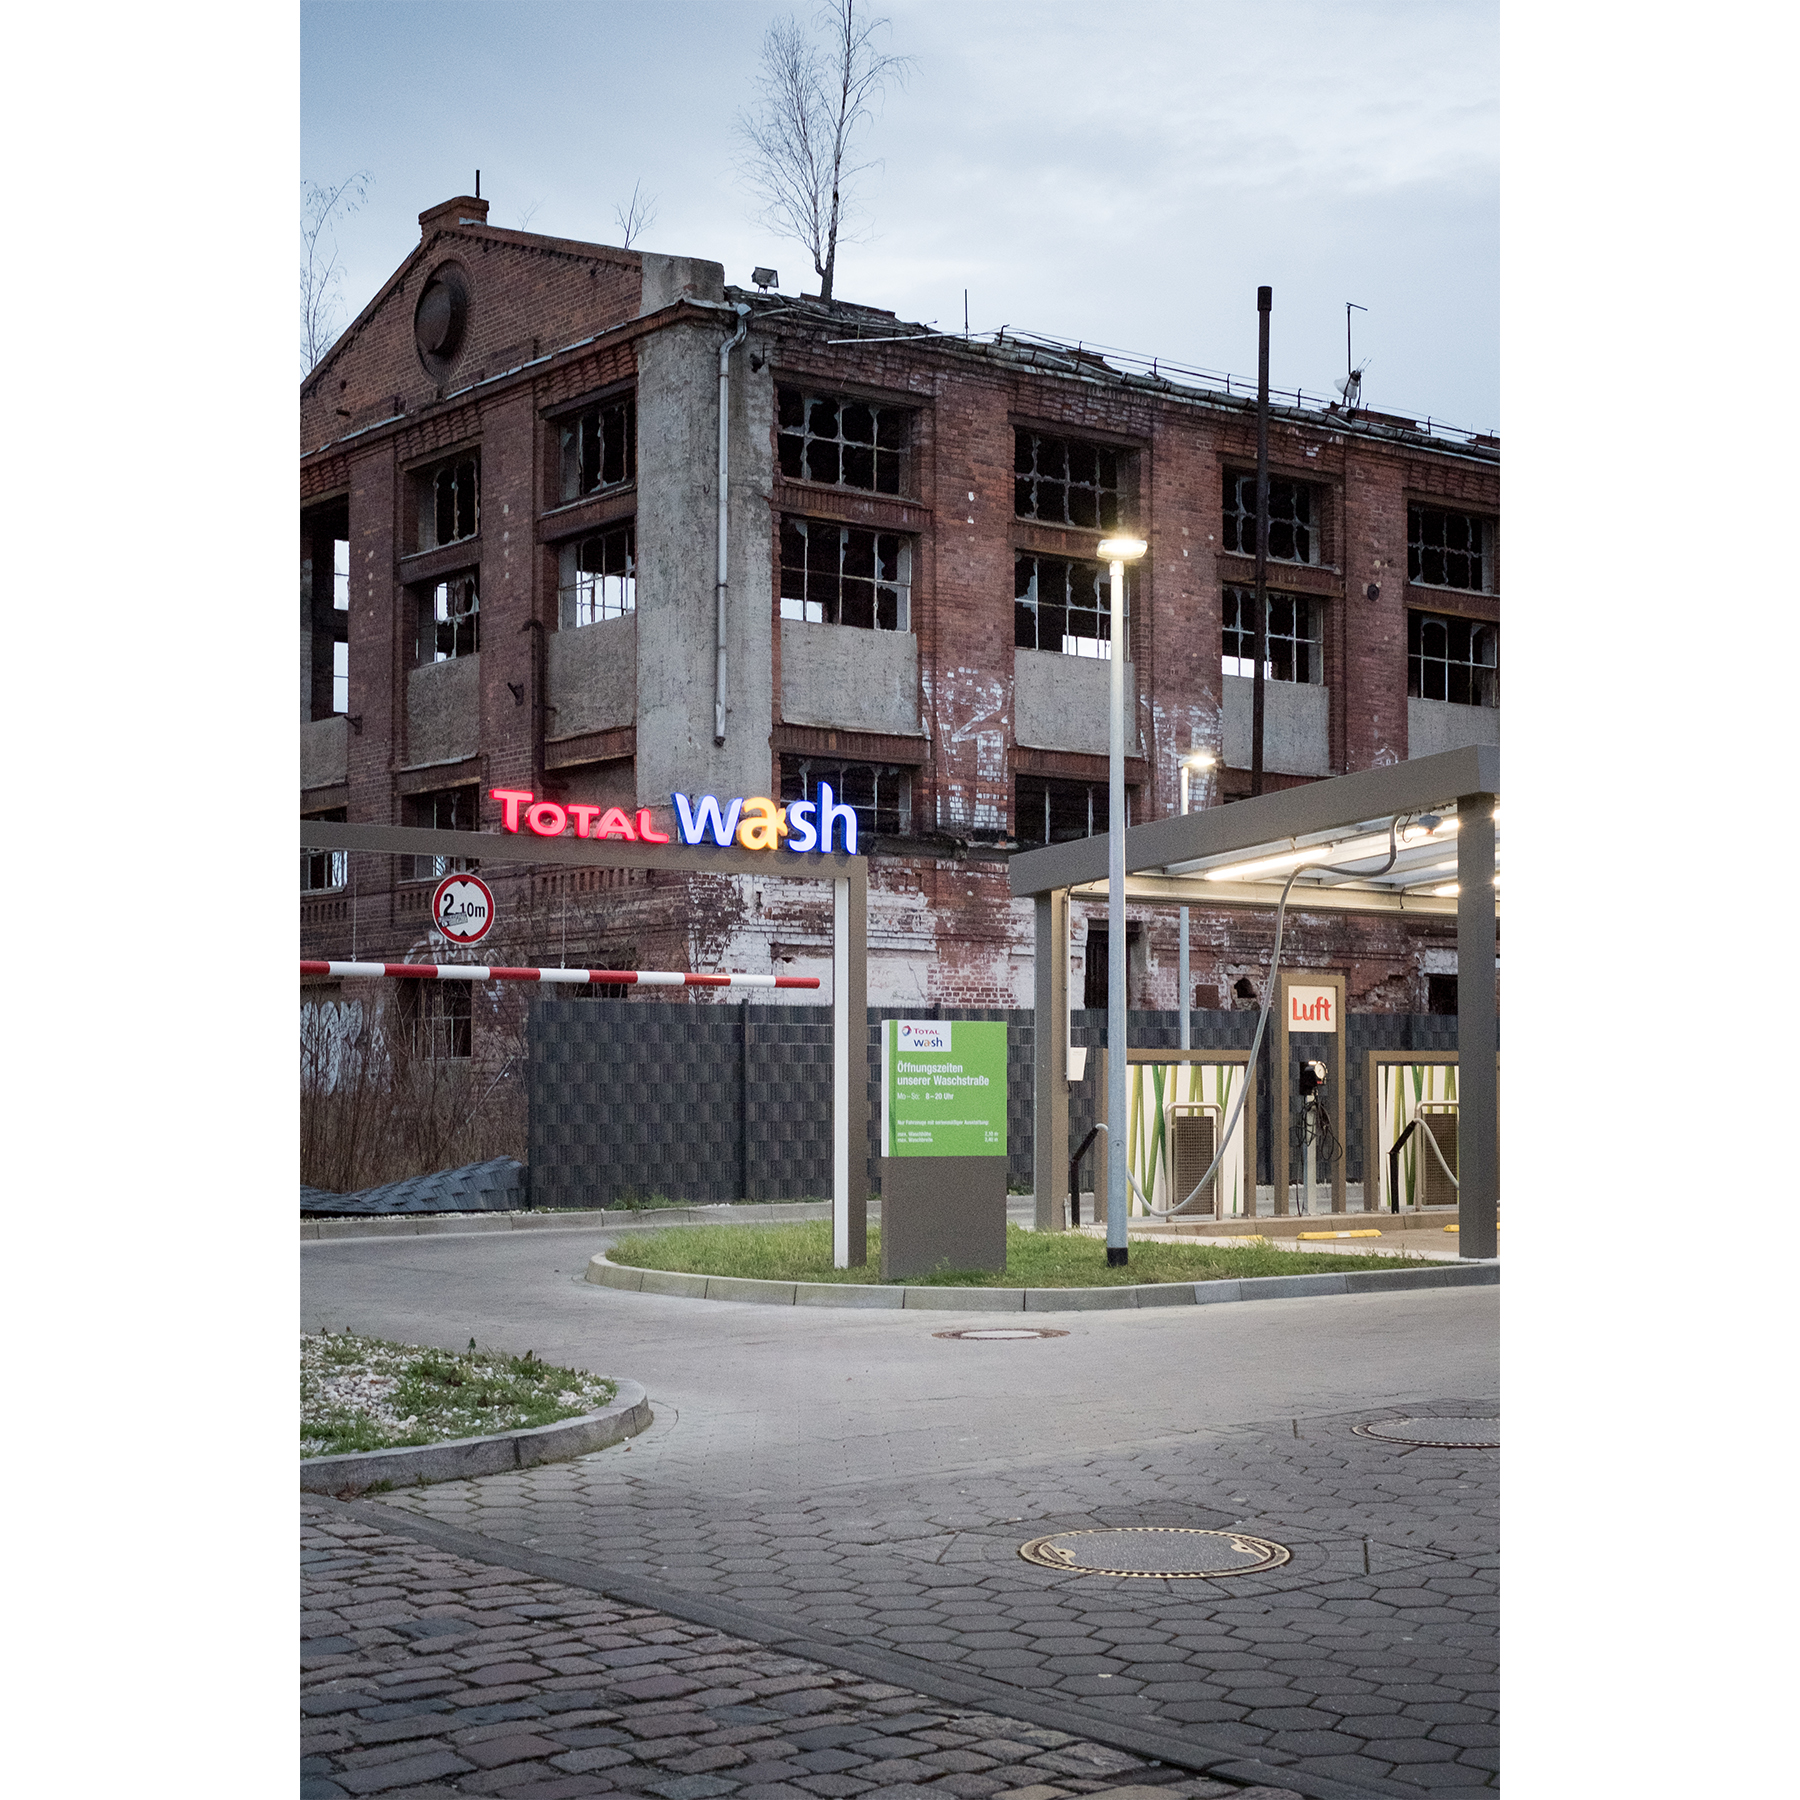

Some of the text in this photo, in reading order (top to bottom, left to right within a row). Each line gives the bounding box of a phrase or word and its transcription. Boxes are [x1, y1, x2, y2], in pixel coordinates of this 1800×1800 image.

[489, 788, 669, 843] TOTAL
[1292, 996, 1332, 1021] Luft
[914, 1028, 940, 1036] TOTAL
[914, 1037, 943, 1048] wash
[897, 1060, 963, 1075] Öffnungszeiten
[897, 1075, 990, 1086] unserer Waschstraße
[943, 1092, 954, 1100] Uhr
